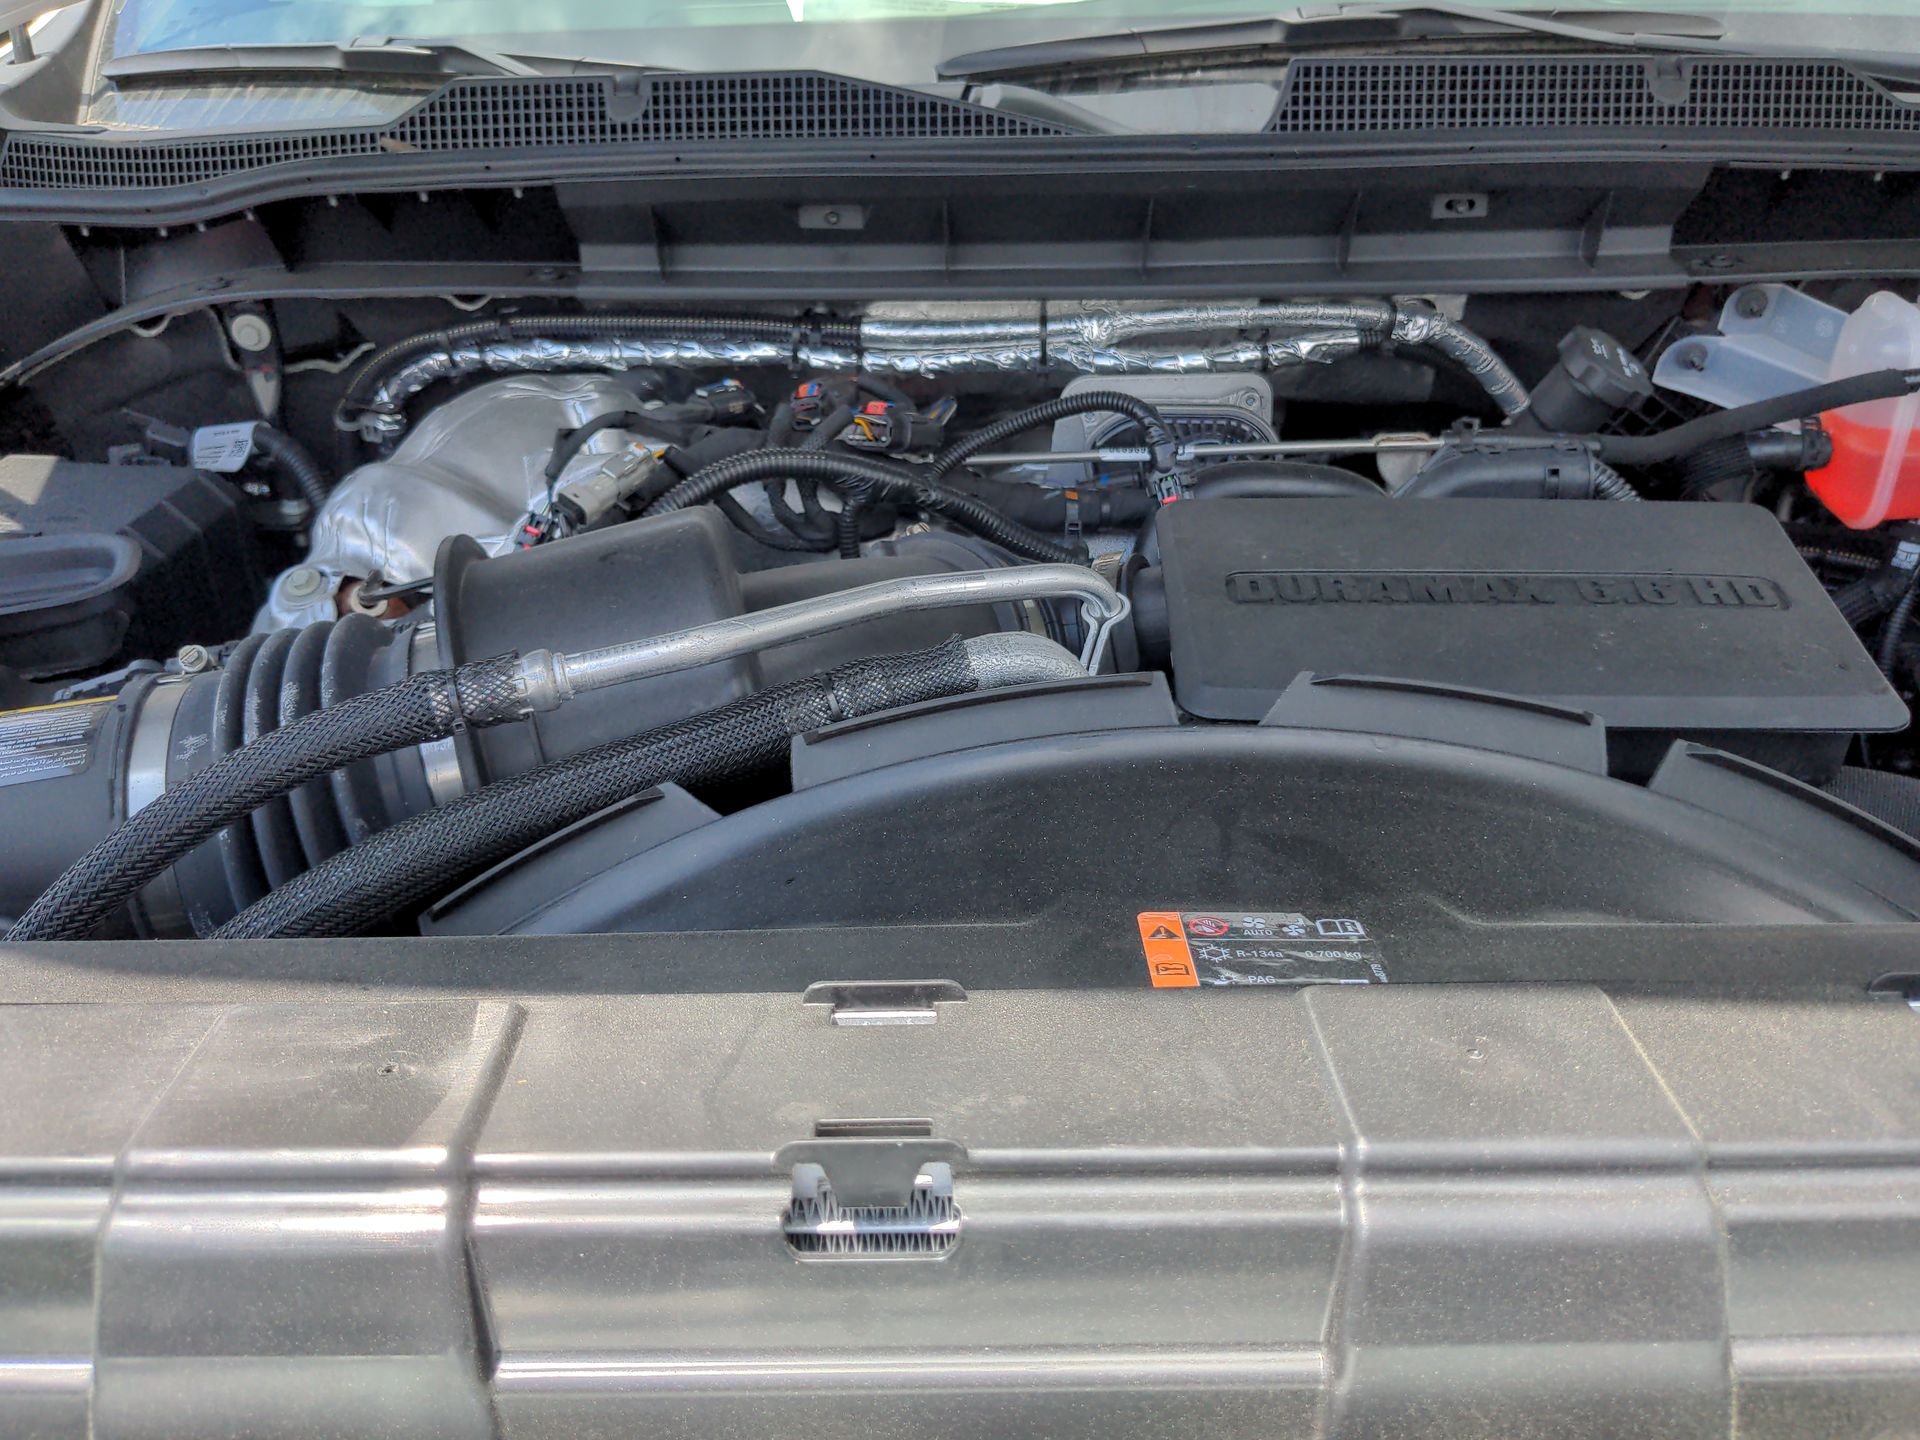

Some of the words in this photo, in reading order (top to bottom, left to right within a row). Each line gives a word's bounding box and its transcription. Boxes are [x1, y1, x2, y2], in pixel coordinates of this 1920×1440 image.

[1236, 574, 1557, 604] DURAMAX
[1574, 576, 1680, 606] 6.6
[1688, 577, 1780, 608] HD
[1243, 928, 1273, 937] AUTO
[1236, 950, 1284, 959] R-134a
[1304, 950, 1341, 959] 0.700
[1247, 975, 1276, 984] PAG
